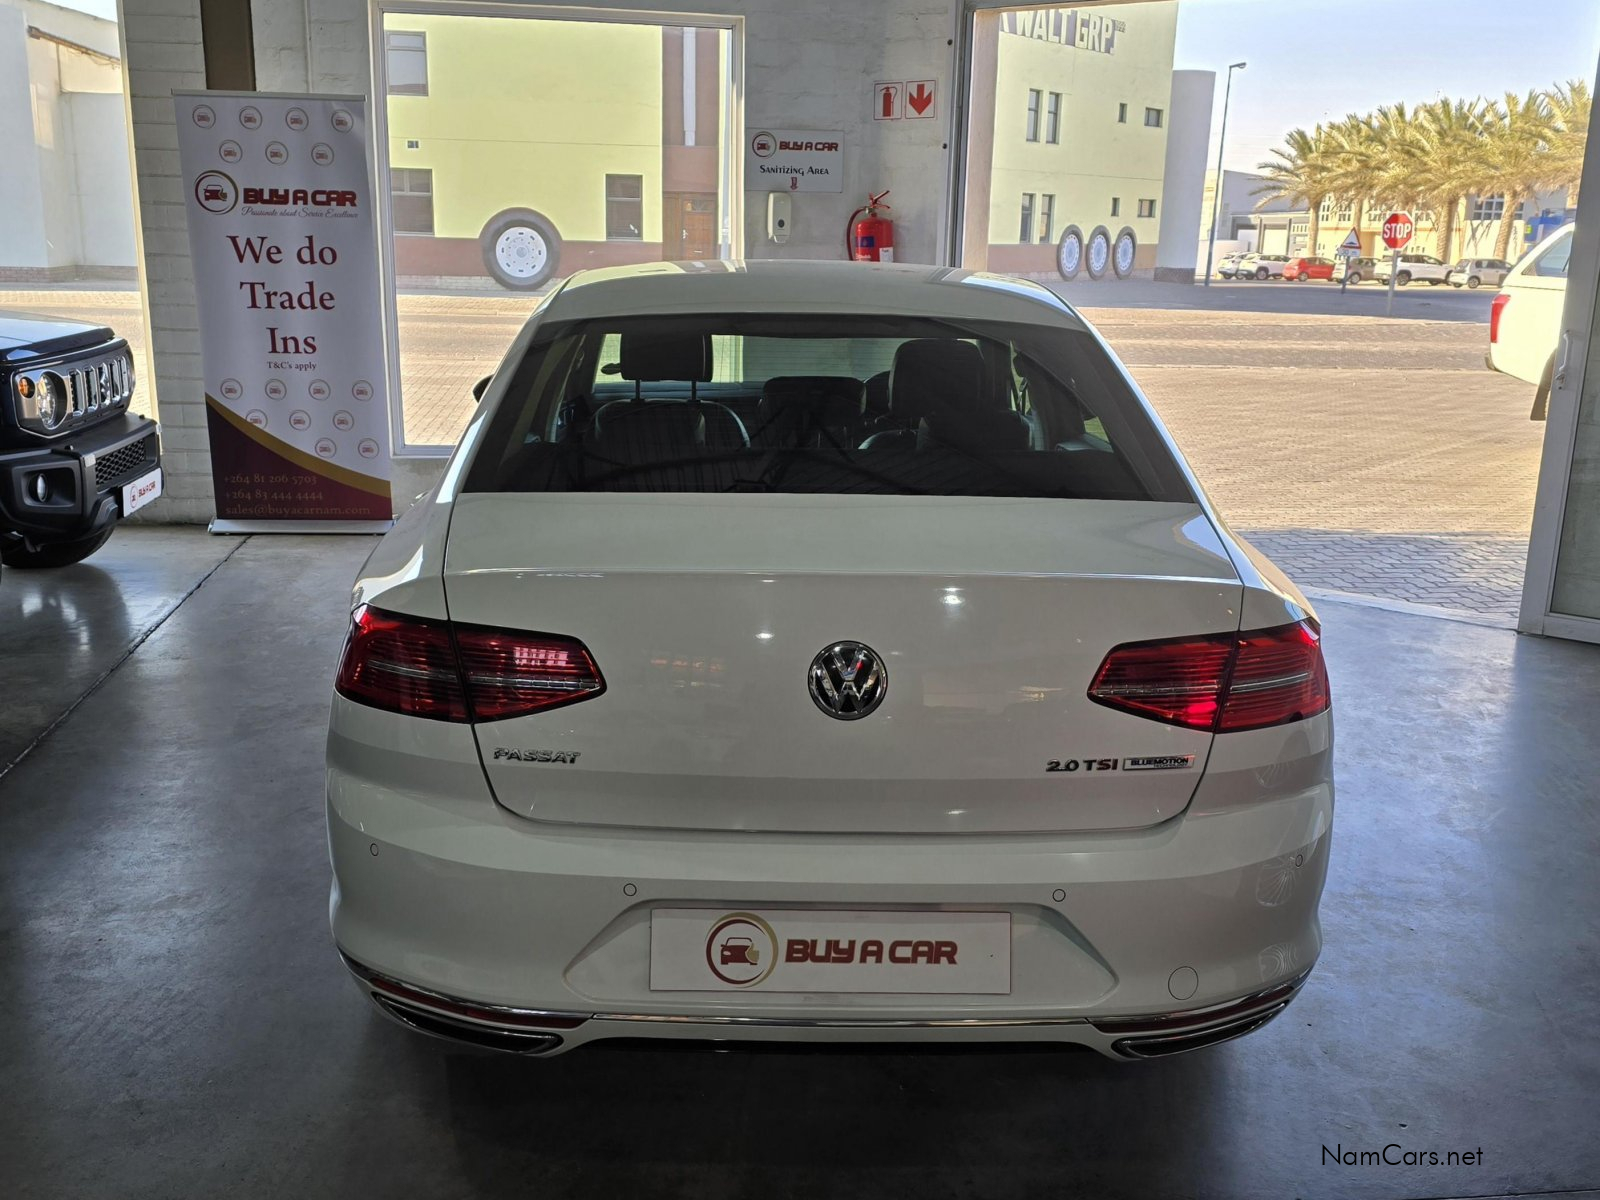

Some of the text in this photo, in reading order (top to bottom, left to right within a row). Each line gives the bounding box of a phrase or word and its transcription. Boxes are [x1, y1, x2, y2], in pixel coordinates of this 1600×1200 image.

[1016, 9, 1072, 45] WALT
[779, 141, 838, 152] BUY A CAR
[243, 187, 357, 207] BUY A CAR
[1383, 223, 1412, 239] STOP
[226, 235, 337, 265] We do
[239, 280, 335, 311] Trade
[265, 327, 317, 354] Ins
[267, 361, 317, 371] T&C's apply
[224, 474, 250, 484] +264
[254, 474, 265, 483] 81
[269, 474, 288, 484] 206
[225, 489, 251, 500] +264
[271, 491, 292, 500] 444
[295, 491, 323, 501] 4444
[493, 747, 581, 764] PASSAT
[1046, 757, 1189, 772] 2.0 TSI BLUEMOTION
[785, 939, 958, 965] BUY A CAR
